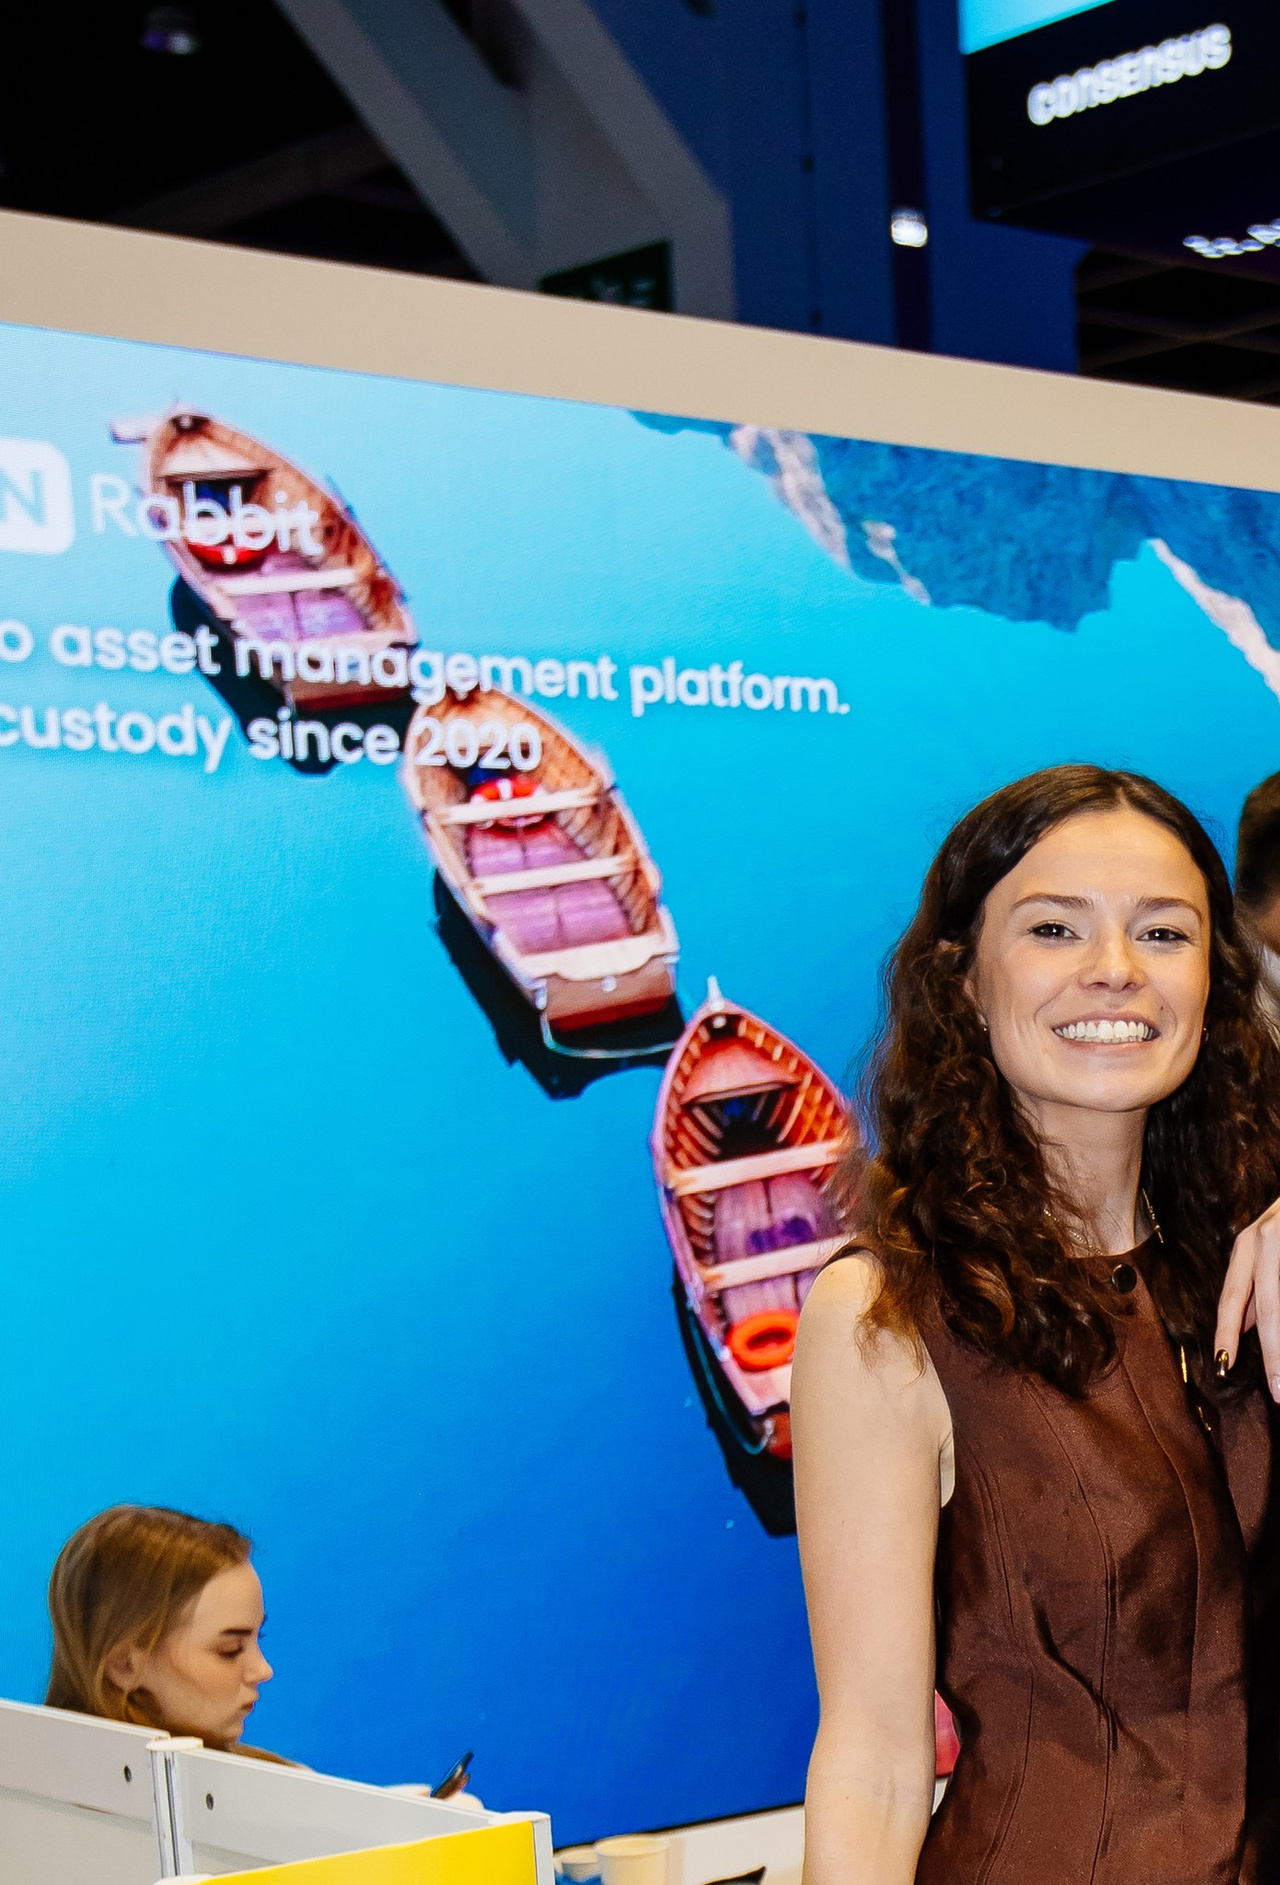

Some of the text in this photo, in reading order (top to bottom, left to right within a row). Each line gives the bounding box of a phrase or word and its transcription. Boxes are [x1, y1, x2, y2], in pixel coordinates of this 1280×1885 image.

[88, 471, 324, 556] Rabbit
[49, 622, 222, 676] asset
[234, 636, 620, 705] management
[630, 656, 851, 718] platform.
[247, 705, 400, 765] since
[415, 716, 543, 772] 2020
